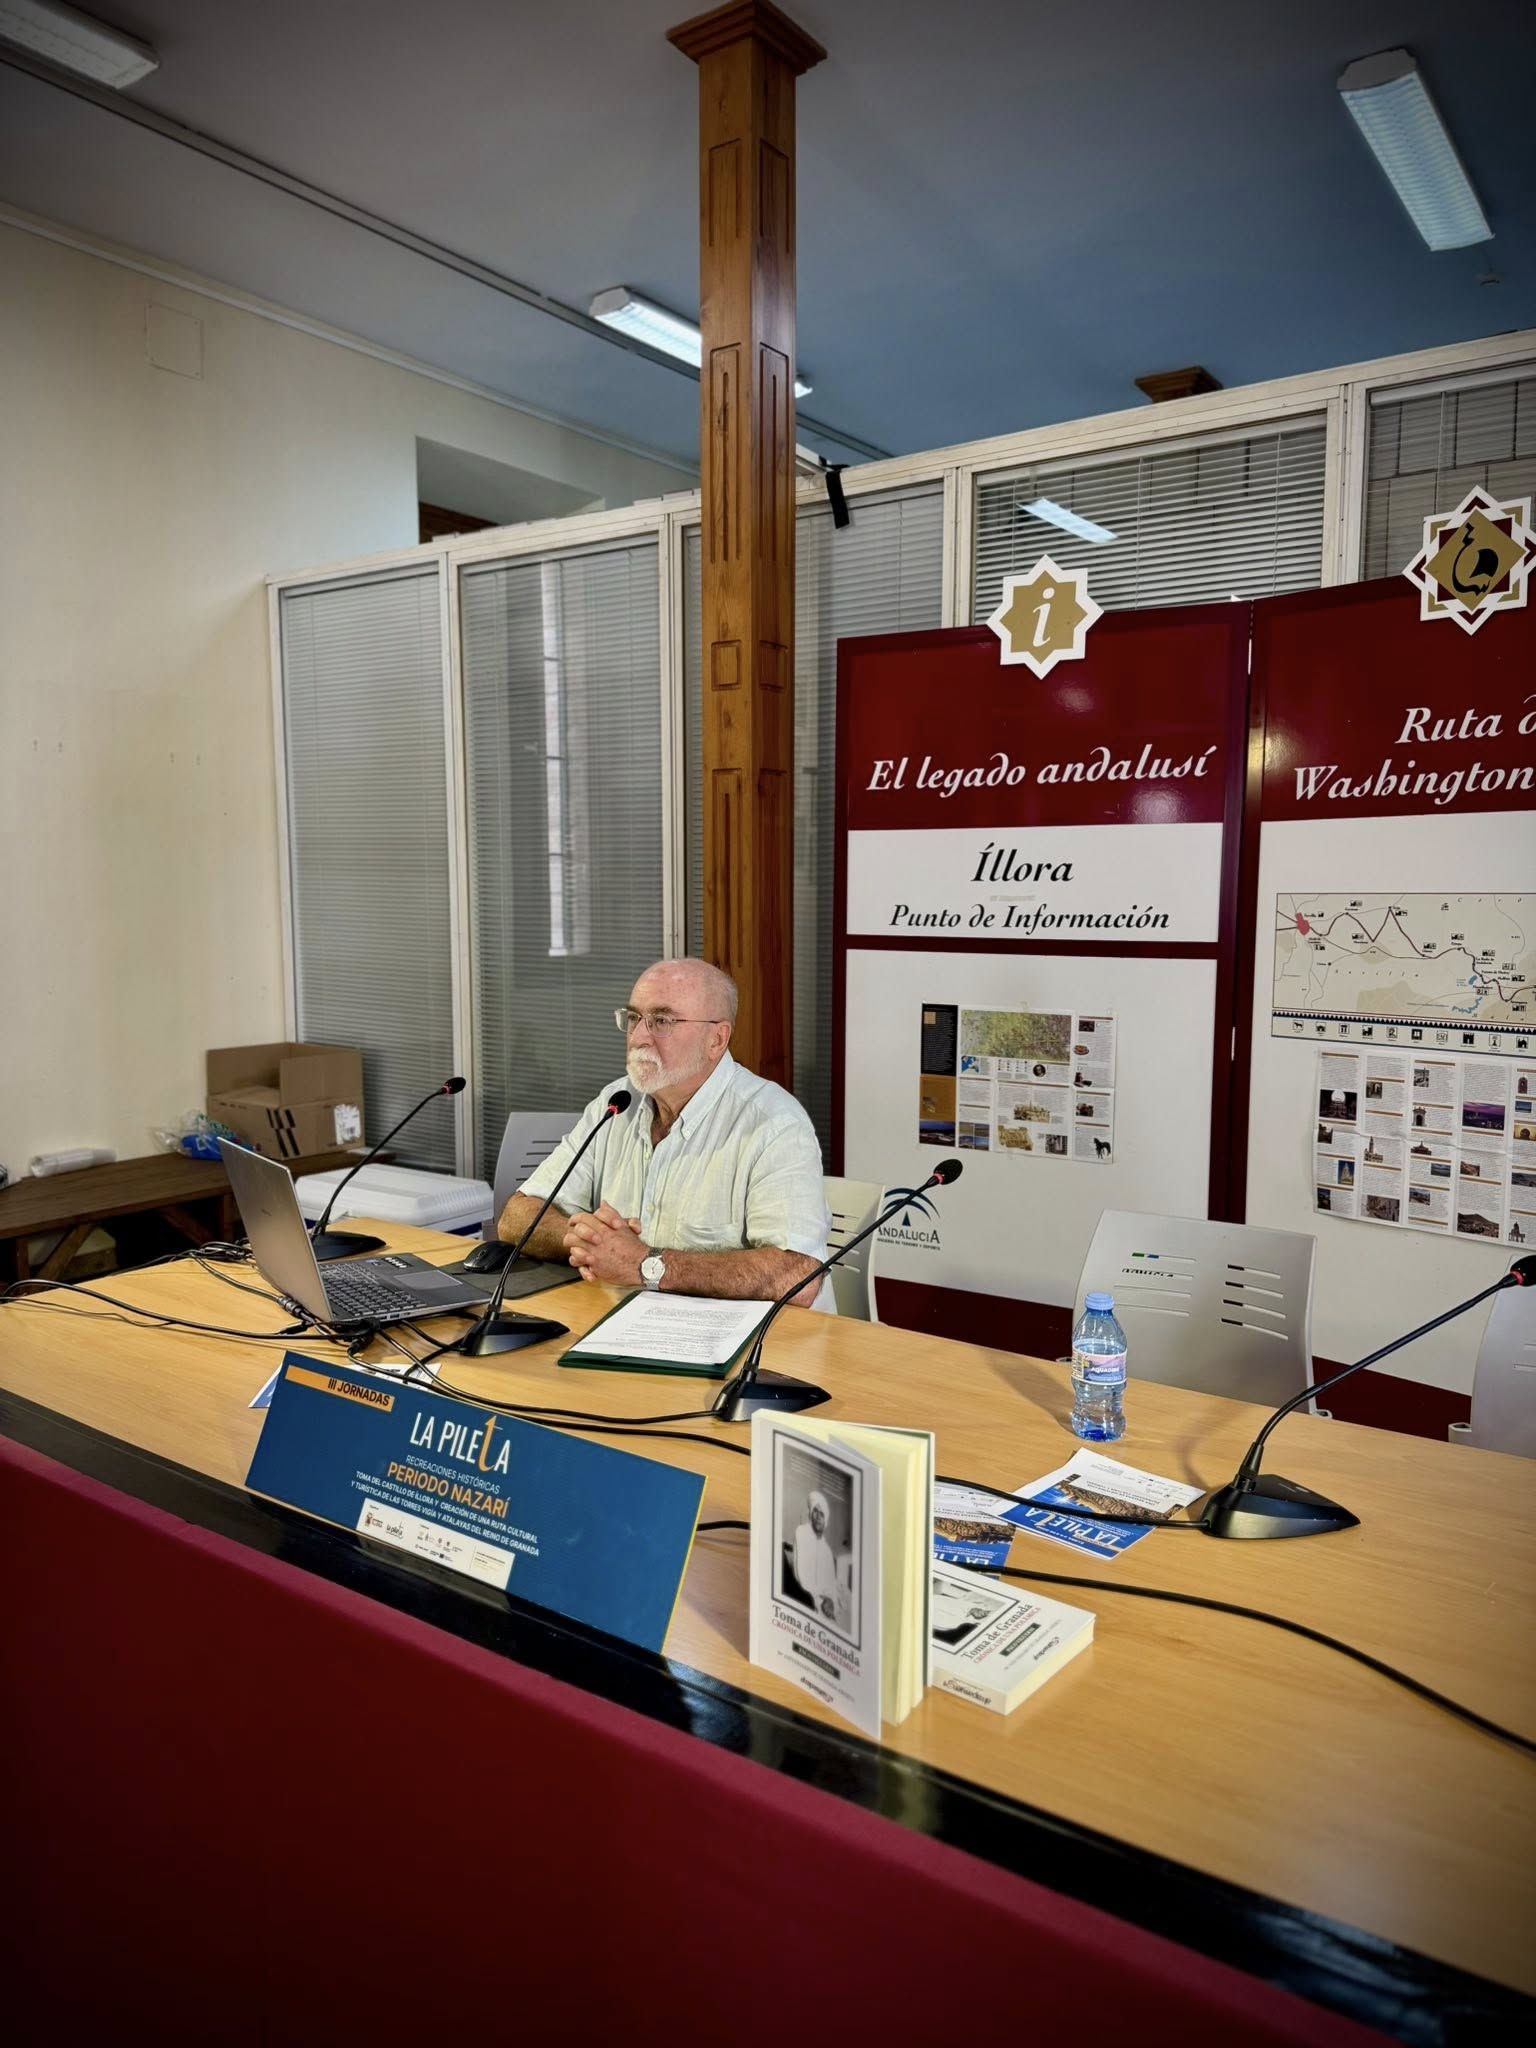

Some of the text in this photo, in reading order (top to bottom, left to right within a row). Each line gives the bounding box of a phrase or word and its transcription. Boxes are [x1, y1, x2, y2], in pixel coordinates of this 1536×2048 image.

[1394, 707, 1504, 744] Ruta
[866, 743, 1218, 799] El legado andalusí
[1293, 758, 1536, 806] Washington
[970, 842, 1074, 883] Íllora
[889, 903, 1170, 936] Punto de Información
[328, 1377, 391, 1407] III JORNADAS
[409, 1412, 435, 1449] LA
[387, 1461, 512, 1519] PERIODO NAZARÍ
[405, 1454, 501, 1495] RECREACIONES HISTÓRICAS
[351, 1481, 356, 1489] Y
[381, 1490, 390, 1500] DE
[389, 1494, 401, 1505] LAS
[400, 1497, 422, 1513] TORRES
[437, 1510, 443, 1519] Y
[442, 1513, 472, 1533] ATALAYAS
[471, 1524, 483, 1537] DEL
[482, 1527, 501, 1542] REINO
[499, 1534, 510, 1546] DE
[509, 1537, 540, 1557] GRANADA
[356, 1471, 371, 1483] TOMA
[371, 1476, 381, 1487] DEL
[381, 1479, 407, 1497] CASTILLO
[407, 1488, 415, 1498] DE
[434, 1498, 440, 1507] Y
[440, 1498, 470, 1519] CREACIÓN
[468, 1510, 478, 1521] DE
[477, 1513, 491, 1525] UNA
[490, 1516, 507, 1532] RUTA
[506, 1524, 539, 1545] CULTURAL
[772, 1604, 802, 1631] Toma
[804, 1622, 817, 1639] de
[818, 1630, 860, 1668] Granada
[961, 1639, 991, 1660] Toma
[986, 1630, 1000, 1643] de
[996, 1603, 1033, 1632] Granada
